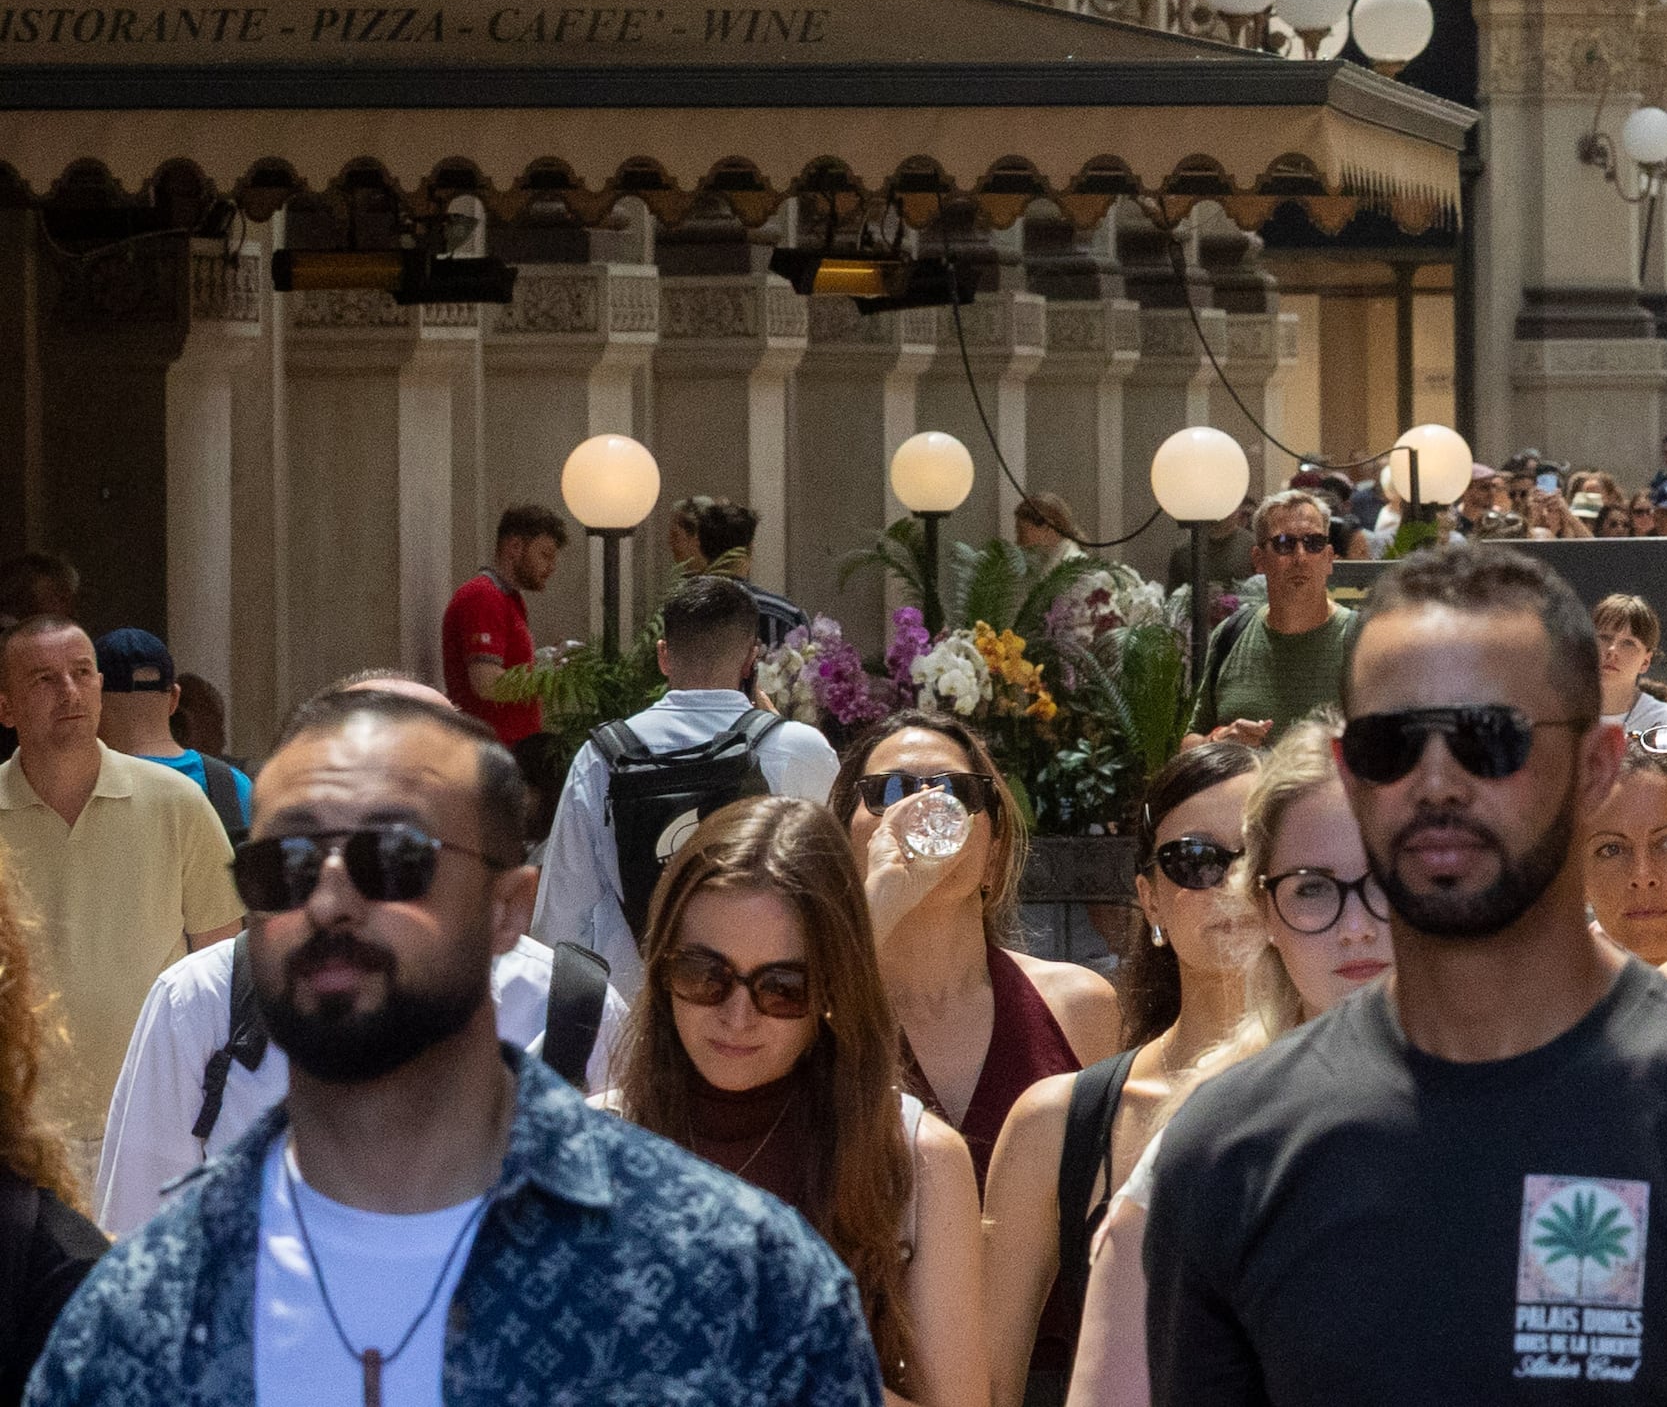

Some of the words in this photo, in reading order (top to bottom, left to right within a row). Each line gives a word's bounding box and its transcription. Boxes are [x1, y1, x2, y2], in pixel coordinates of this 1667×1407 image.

[0, 7, 270, 44] ISTORANTE
[310, 7, 447, 44] PIZZA
[702, 8, 831, 44] WINE
